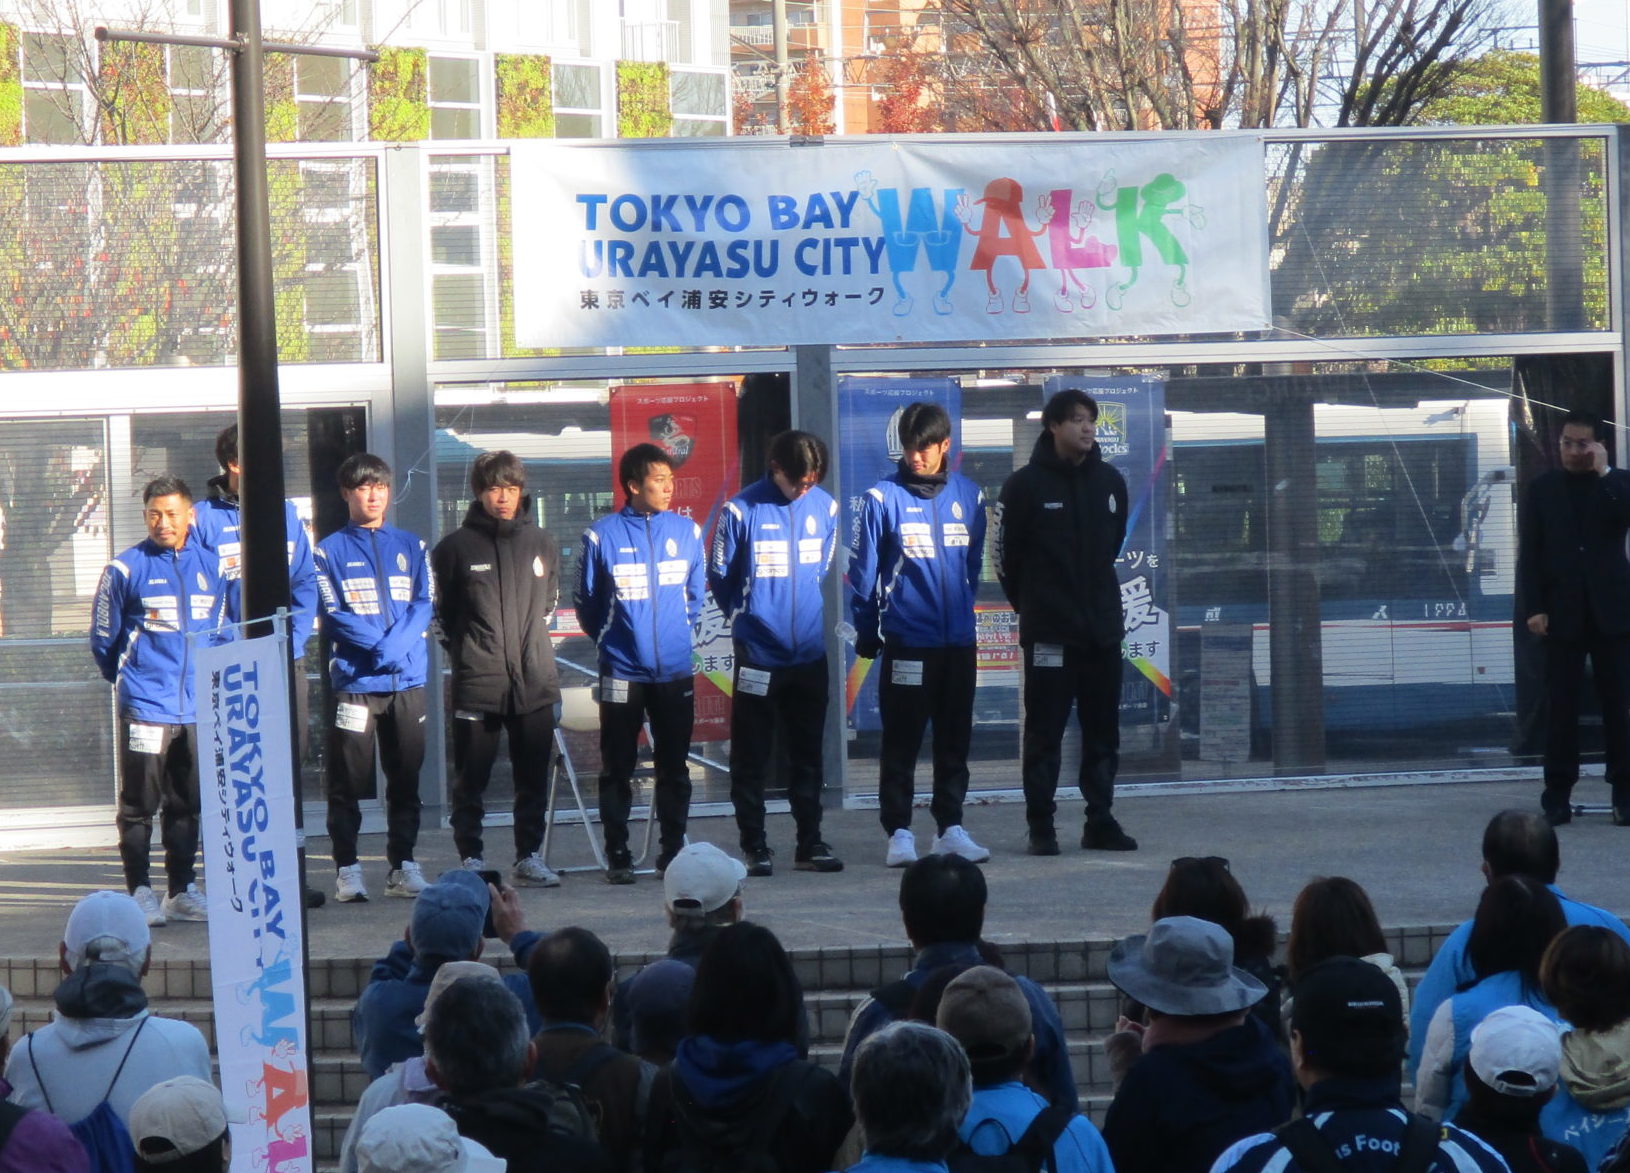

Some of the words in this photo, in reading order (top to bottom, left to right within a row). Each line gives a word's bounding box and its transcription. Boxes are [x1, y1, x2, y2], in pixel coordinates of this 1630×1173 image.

[576, 194, 751, 233] TOKYO
[767, 191, 859, 231] BAY
[576, 239, 780, 279] URAYASU
[794, 237, 886, 277] CITY
[874, 172, 1192, 278] WALK
[580, 287, 885, 310] 東京ベイ浦安シティウォーク
[211, 670, 244, 913] 東京ベイ浦安シティウォーク
[223, 664, 257, 862] URAYASU
[243, 661, 269, 832] TOKYO
[259, 850, 286, 939] BAY
